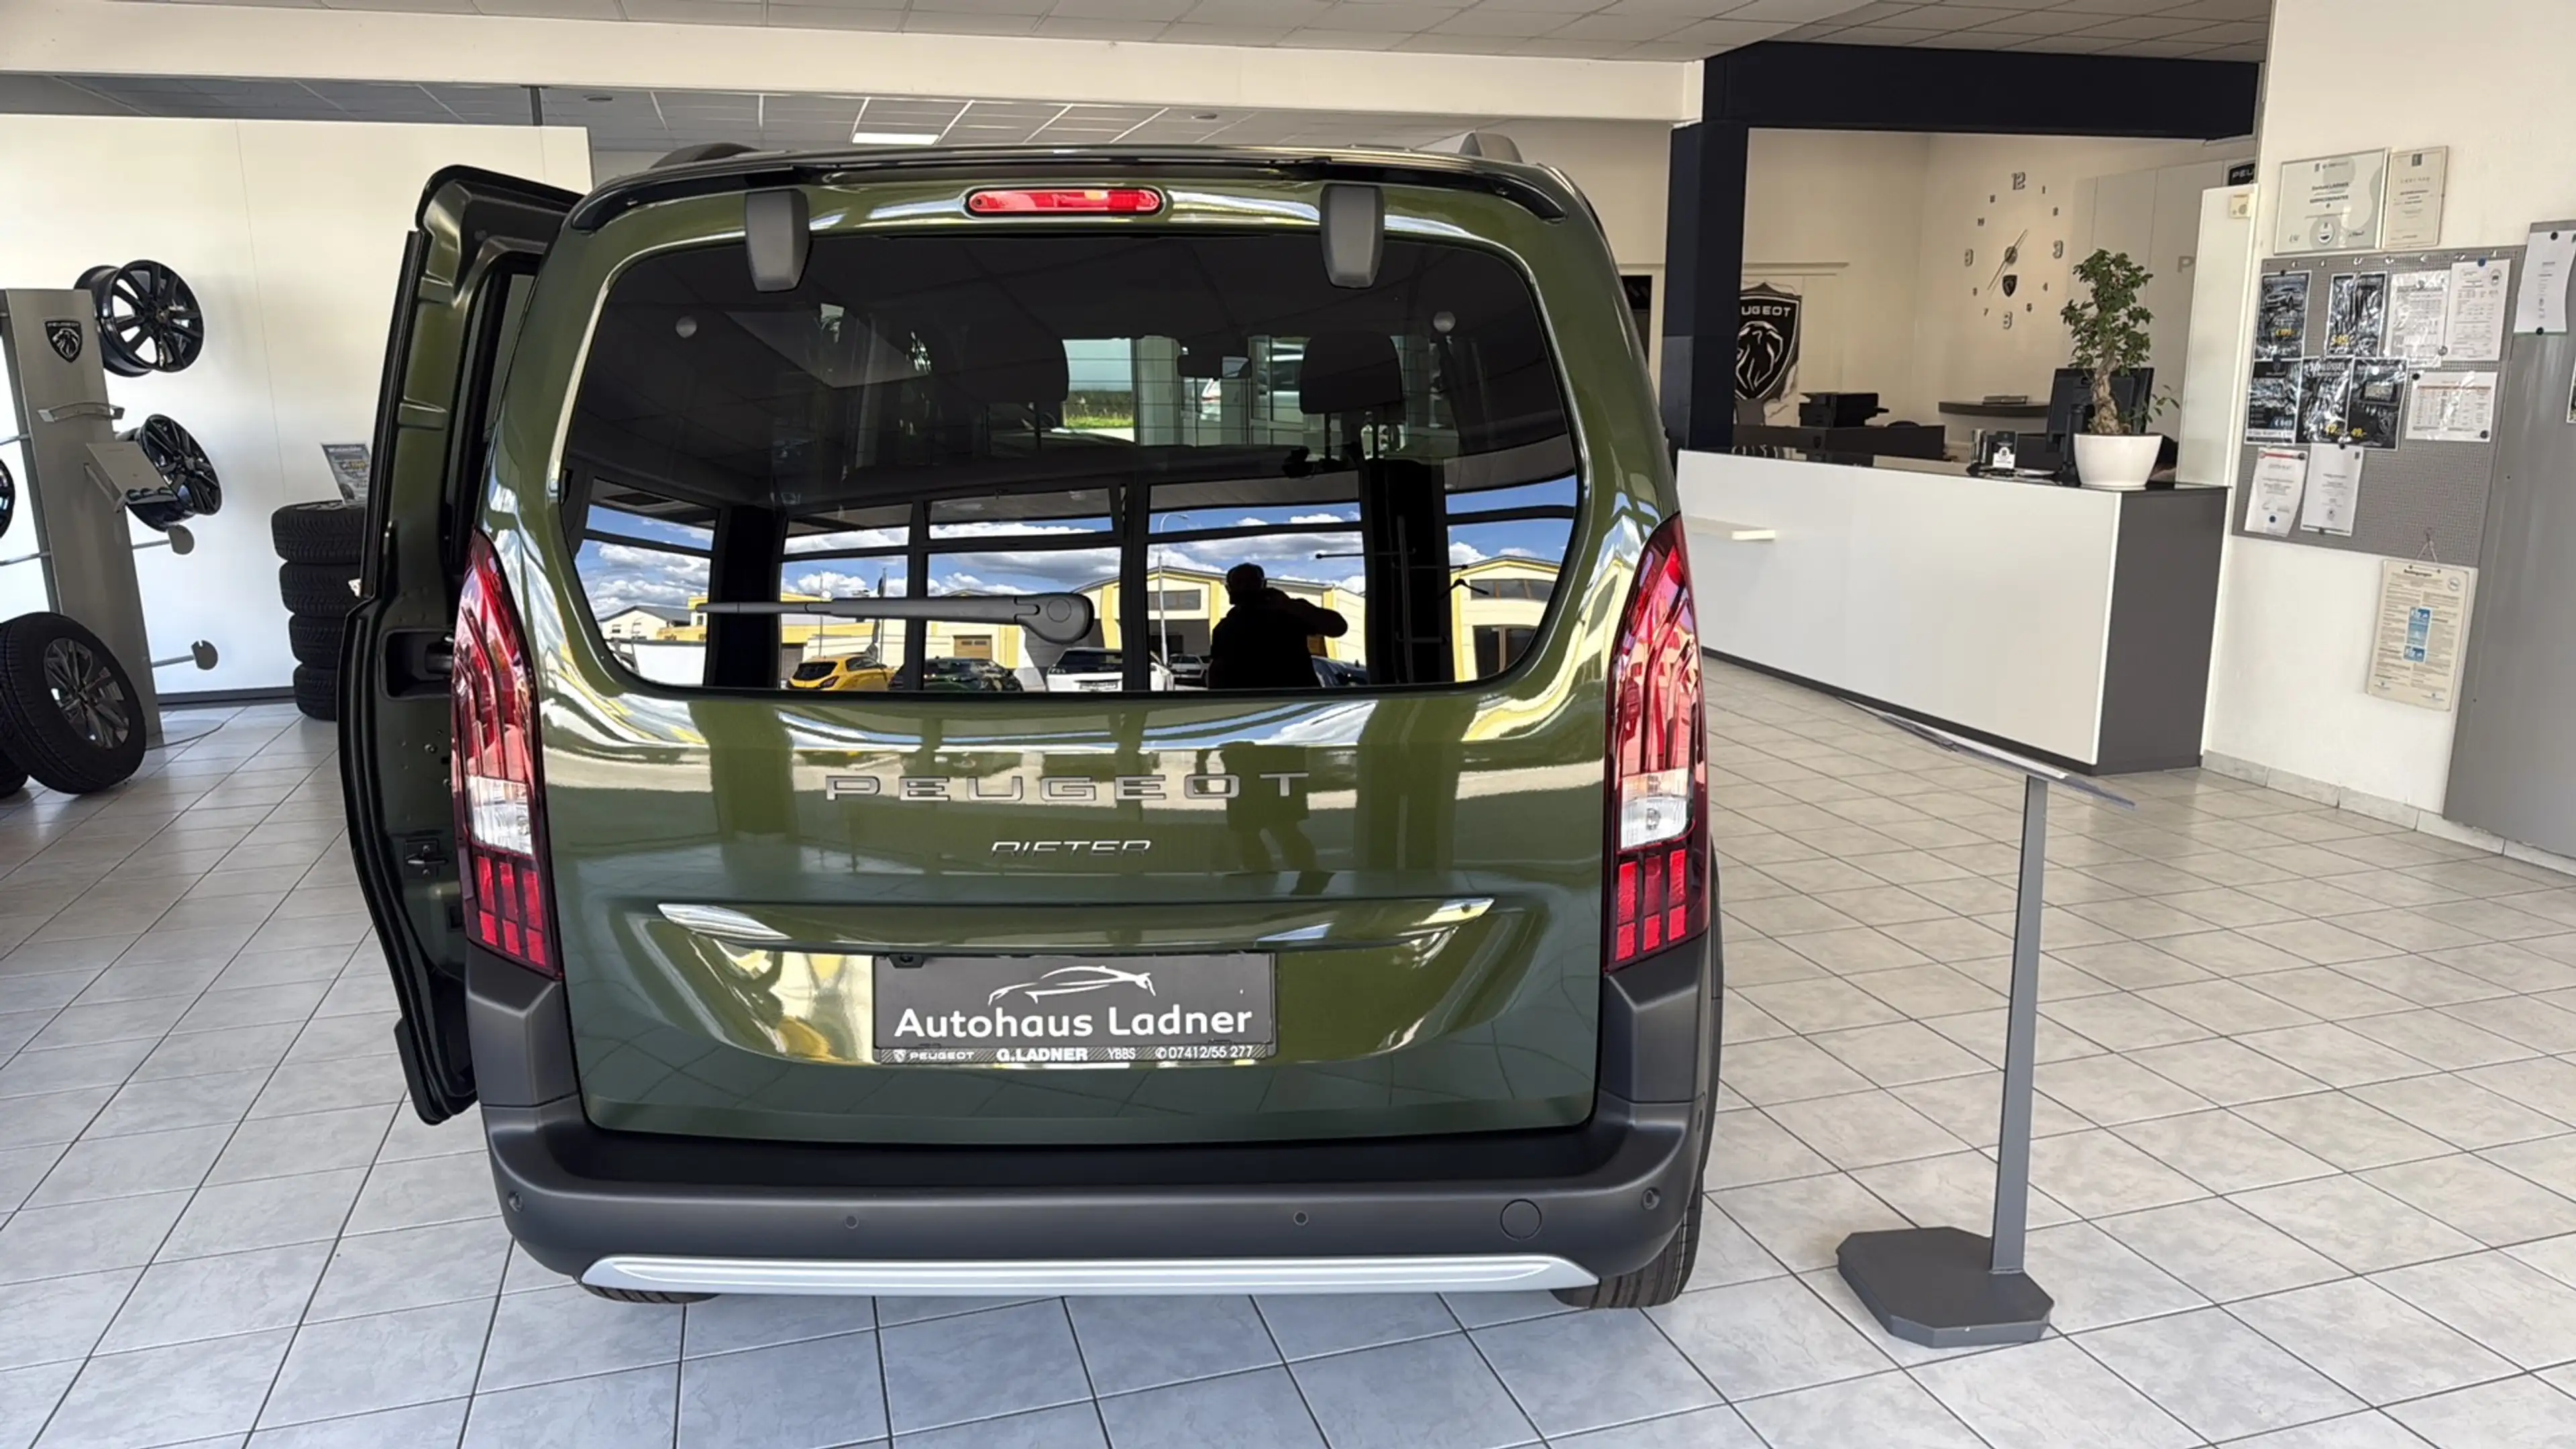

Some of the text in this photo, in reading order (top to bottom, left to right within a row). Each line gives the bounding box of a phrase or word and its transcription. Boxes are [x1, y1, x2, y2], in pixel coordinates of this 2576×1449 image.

[2010, 171, 2027, 191] 12
[2052, 239, 2064, 259] 3
[2177, 256, 2195, 274] P
[1741, 306, 1791, 317] UGEOT
[825, 773, 1309, 802] PEUGEOT
[991, 839, 1152, 857] RIFTER
[894, 1004, 1253, 1038] Autohaus Ladner
[910, 1051, 975, 1061] PEUGEOT
[996, 1047, 1089, 1062] G.LADNER
[1168, 1046, 1227, 1060] 07412/55
[1230, 1045, 1254, 1058] 277
